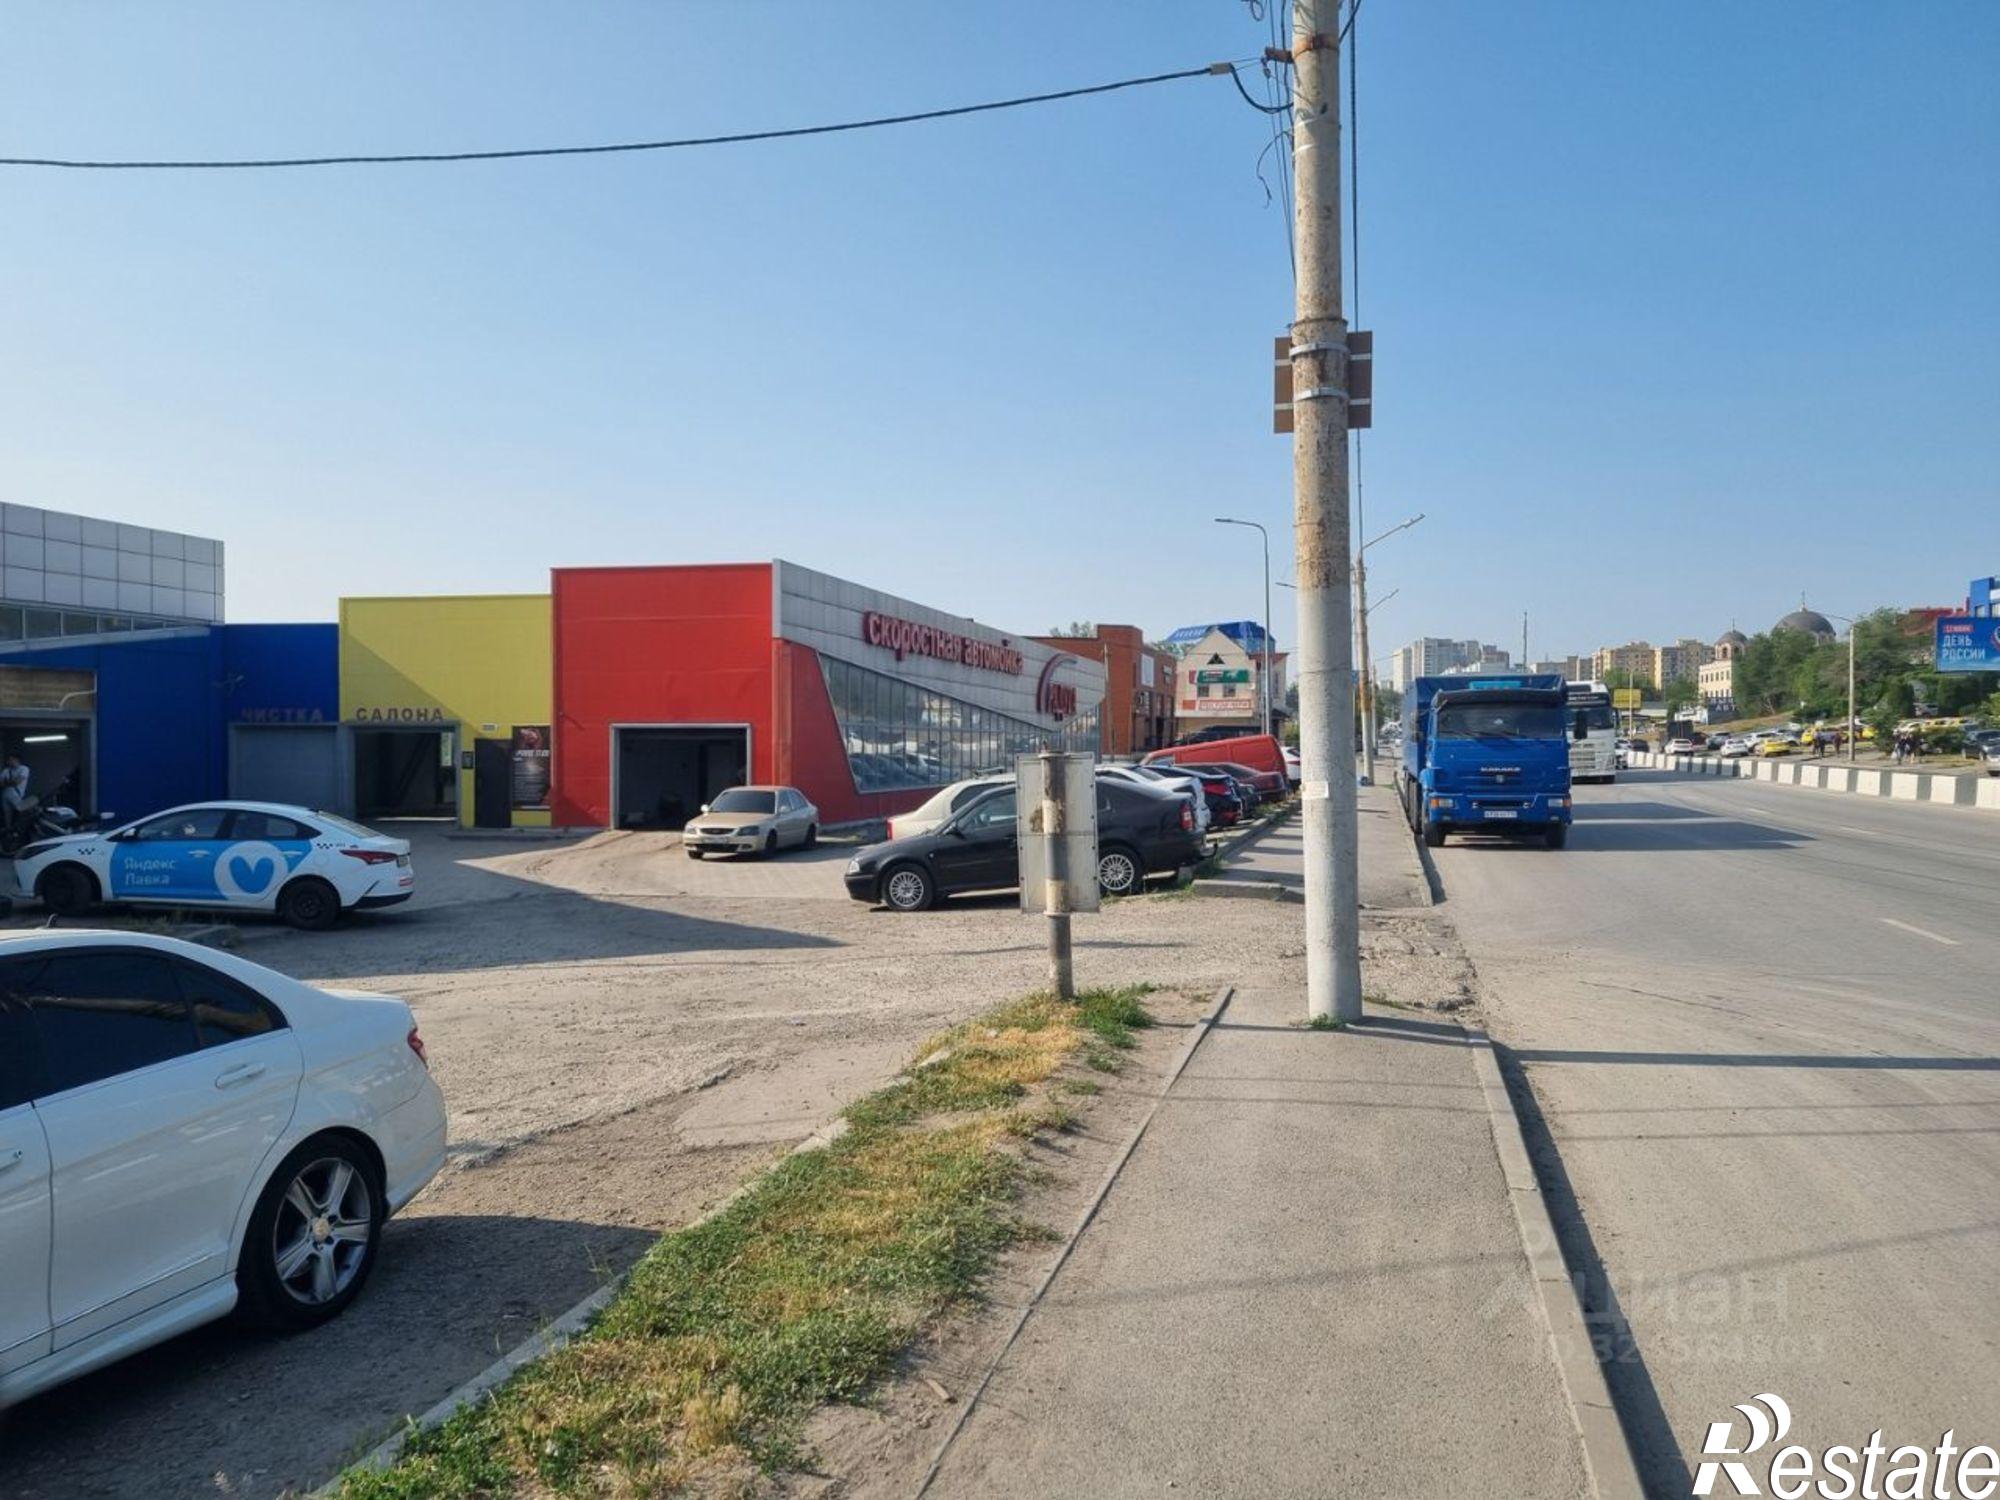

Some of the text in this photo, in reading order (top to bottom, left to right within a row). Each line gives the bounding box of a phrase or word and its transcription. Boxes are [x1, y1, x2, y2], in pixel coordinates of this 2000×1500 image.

[1942, 634, 1973, 647] ДЕНЬ
[1941, 648, 1986, 660] РОССИИ
[241, 706, 445, 722] ЧИСТКА САЛОНА
[123, 856, 176, 870] Яндекс
[123, 873, 170, 886] Лавка
